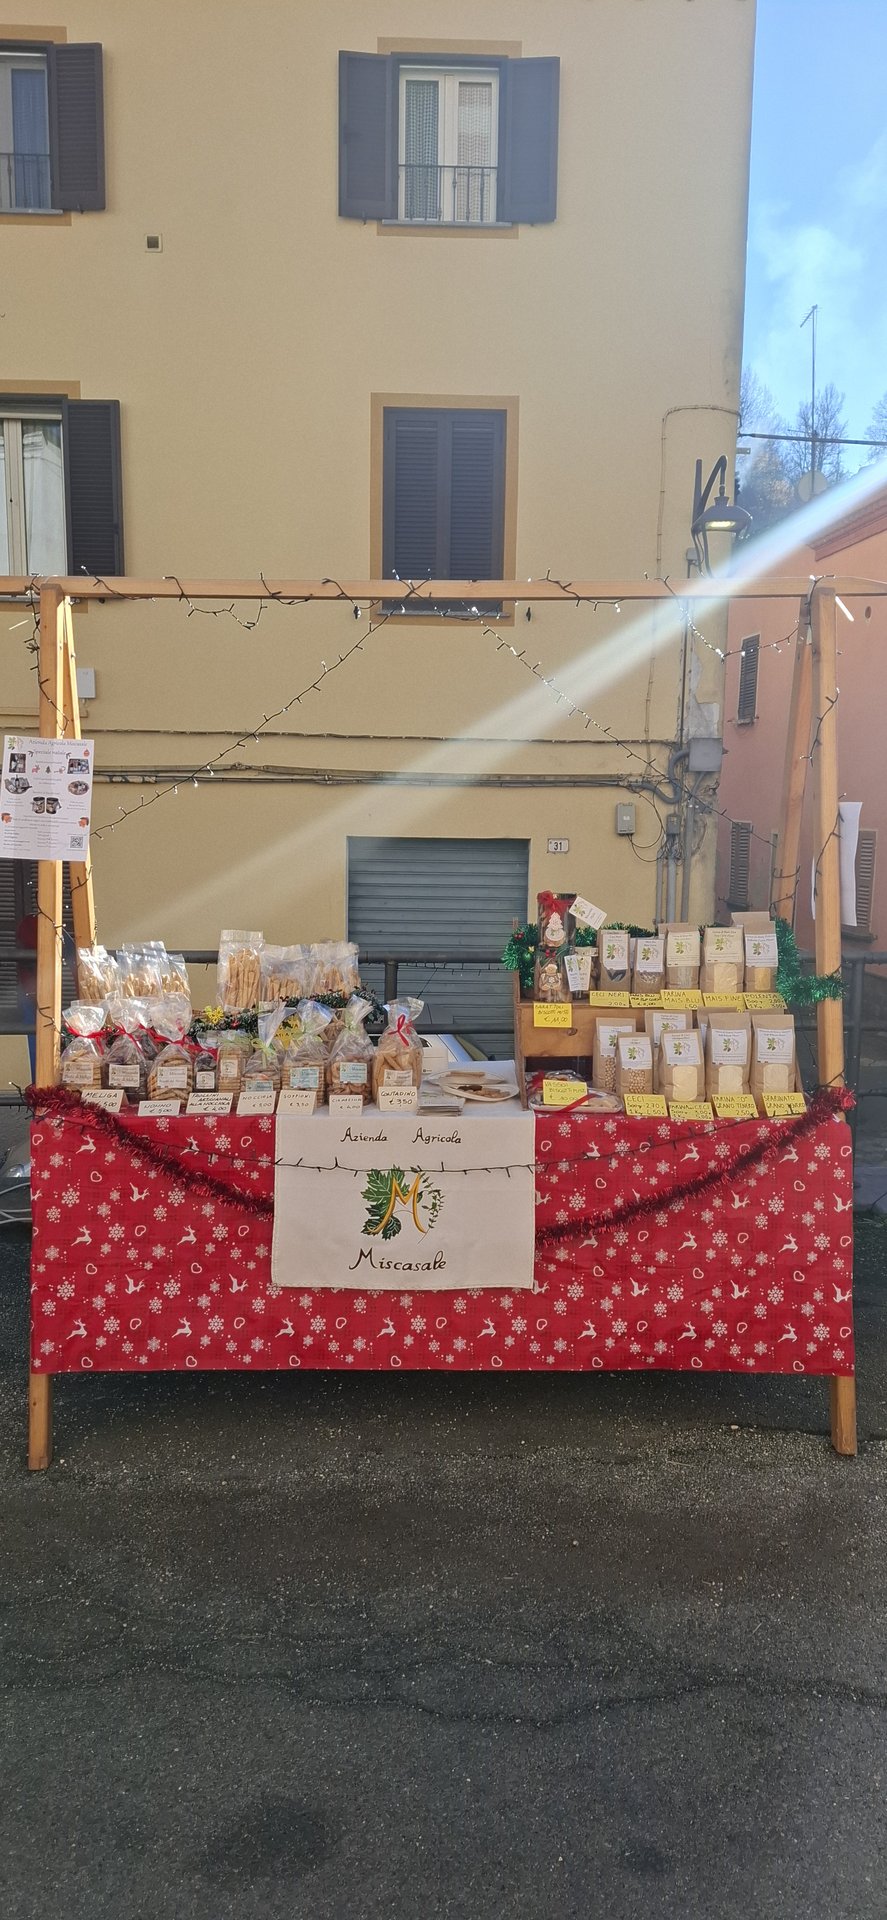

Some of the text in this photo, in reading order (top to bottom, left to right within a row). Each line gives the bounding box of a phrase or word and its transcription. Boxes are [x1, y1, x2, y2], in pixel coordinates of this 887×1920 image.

[553, 841, 563, 851] 31
[340, 1127, 462, 1144] Azienda Agricola
[349, 1247, 447, 1271] Miscasale
